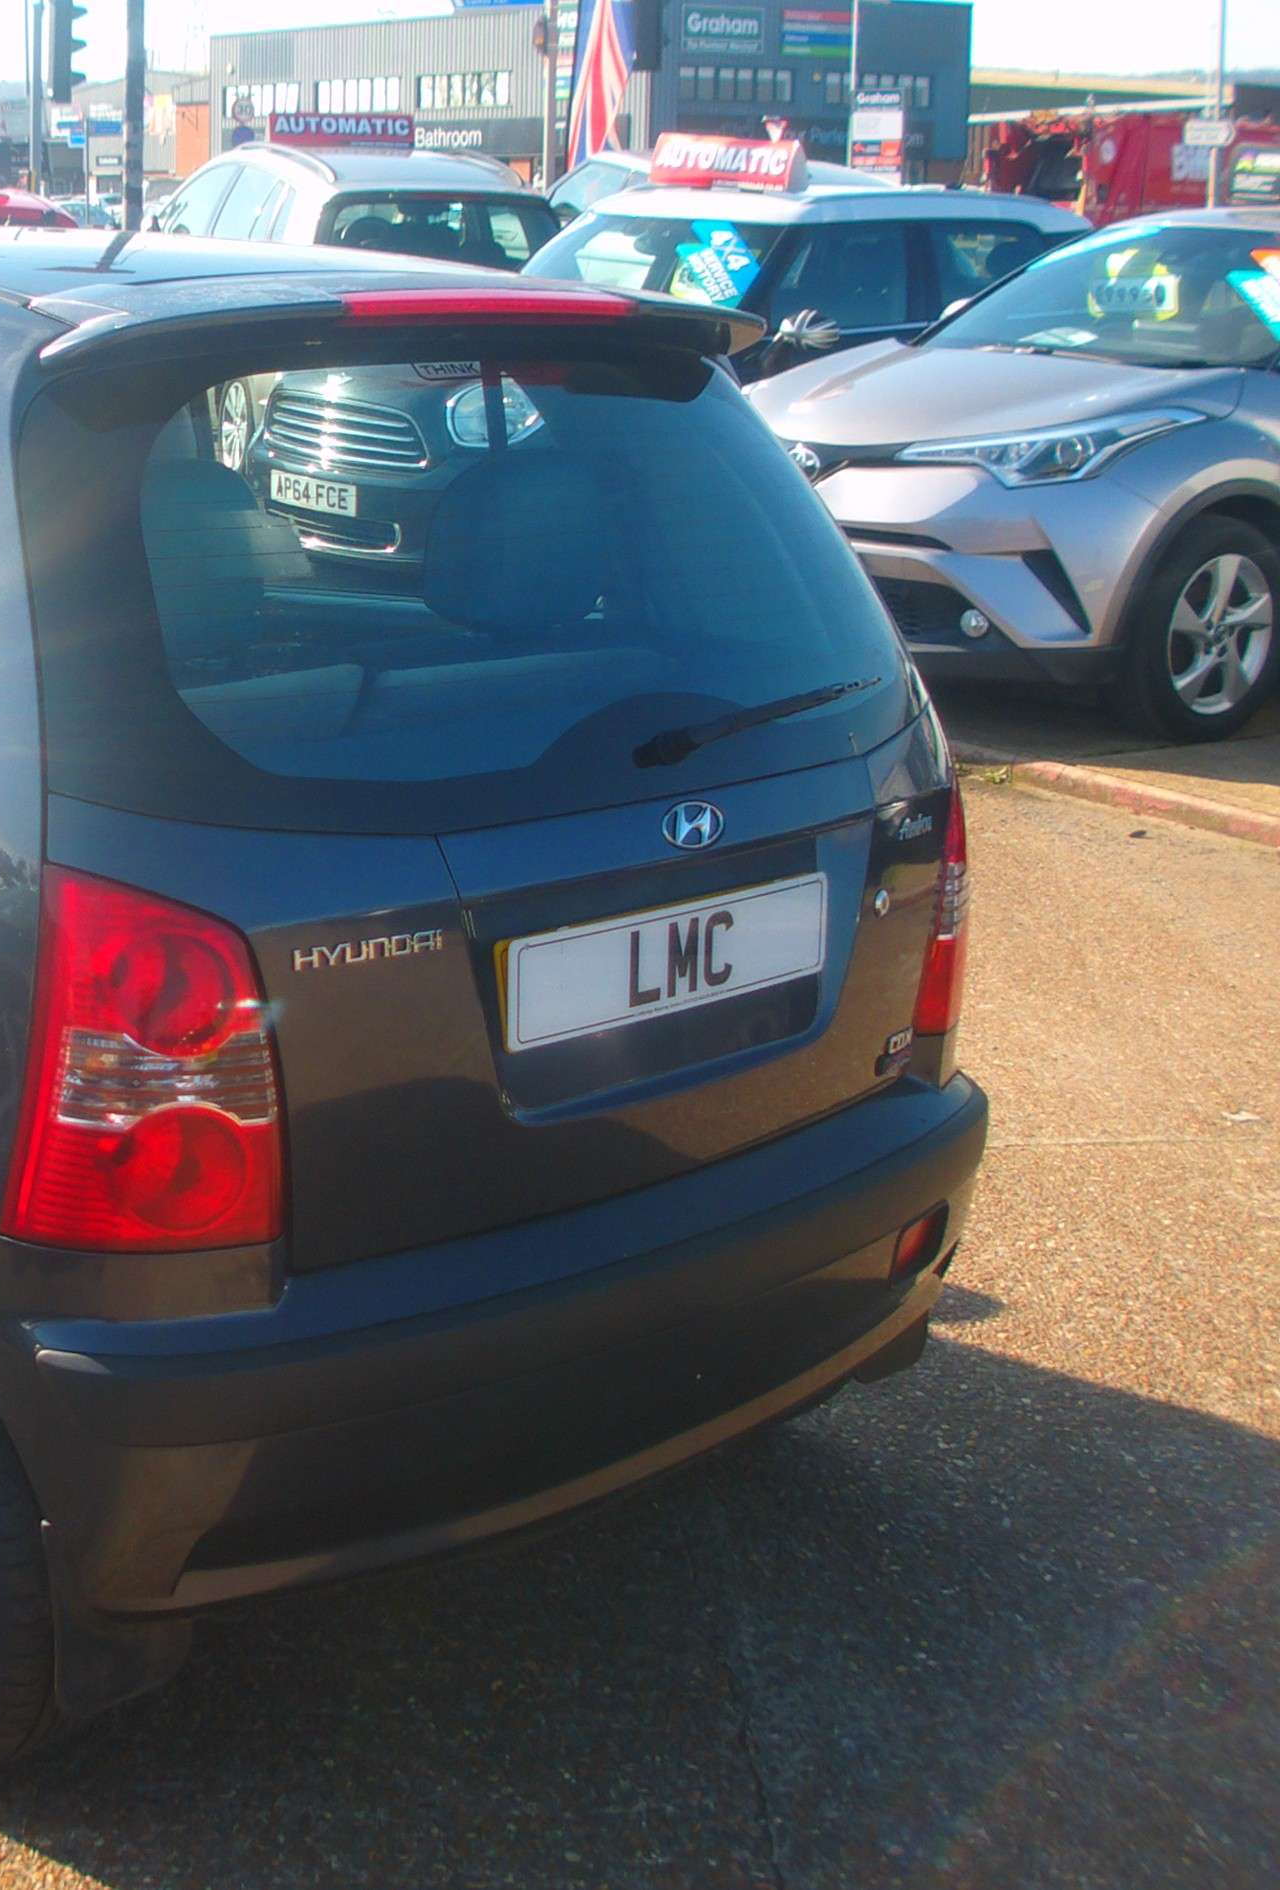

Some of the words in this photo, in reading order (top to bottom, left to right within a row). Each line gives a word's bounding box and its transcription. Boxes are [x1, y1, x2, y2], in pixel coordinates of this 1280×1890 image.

[687, 11, 758, 35] Graham
[274, 116, 410, 136] AUTOMATIC
[415, 128, 482, 147] Bathroom
[655, 141, 788, 176] AUTOMATIC
[276, 475, 311, 503] AP64
[315, 484, 349, 510] FCE
[293, 929, 443, 972] HYUNDAI
[628, 910, 734, 1008] LMC
